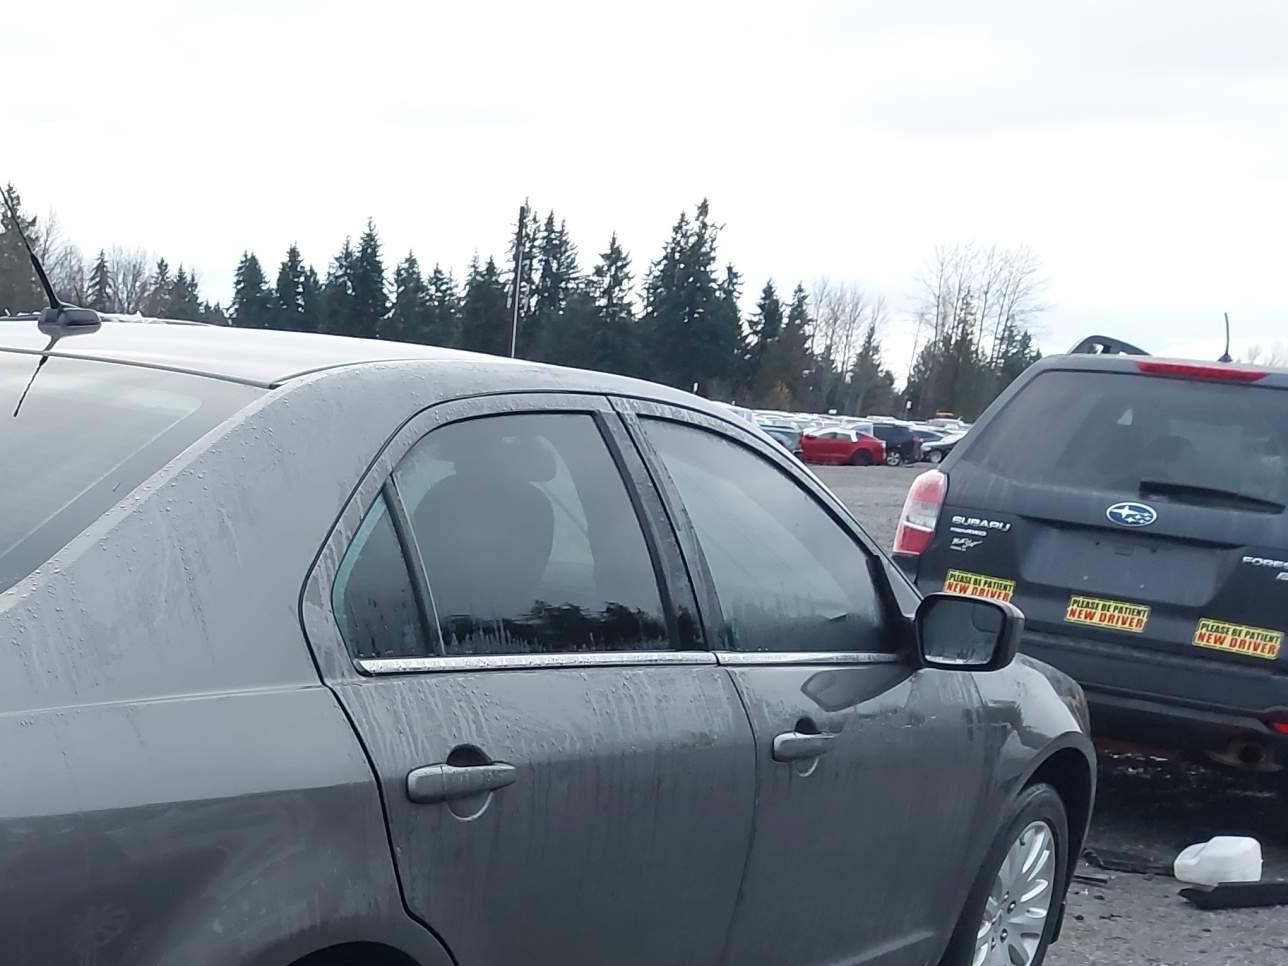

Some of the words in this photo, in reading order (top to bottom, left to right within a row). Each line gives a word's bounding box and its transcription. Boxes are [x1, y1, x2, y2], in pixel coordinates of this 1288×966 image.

[951, 515, 1011, 532] SUBARU
[946, 581, 969, 595] NEW
[971, 586, 1010, 602] DRIVER
[949, 573, 972, 585] PLEASE
[973, 577, 983, 586] BE
[983, 579, 1013, 593] PATIENT
[1068, 607, 1097, 621] NEW
[1098, 611, 1145, 629] DRIVER
[1071, 598, 1099, 611] PLEASE
[1100, 603, 1112, 613] BE
[1112, 605, 1147, 618] PATIENT
[1196, 631, 1226, 646] NEW
[1228, 637, 1278, 655] DRIVER
[1200, 622, 1230, 635] PLEASE
[1231, 627, 1243, 638] BE
[1244, 629, 1280, 644] PATIENT
